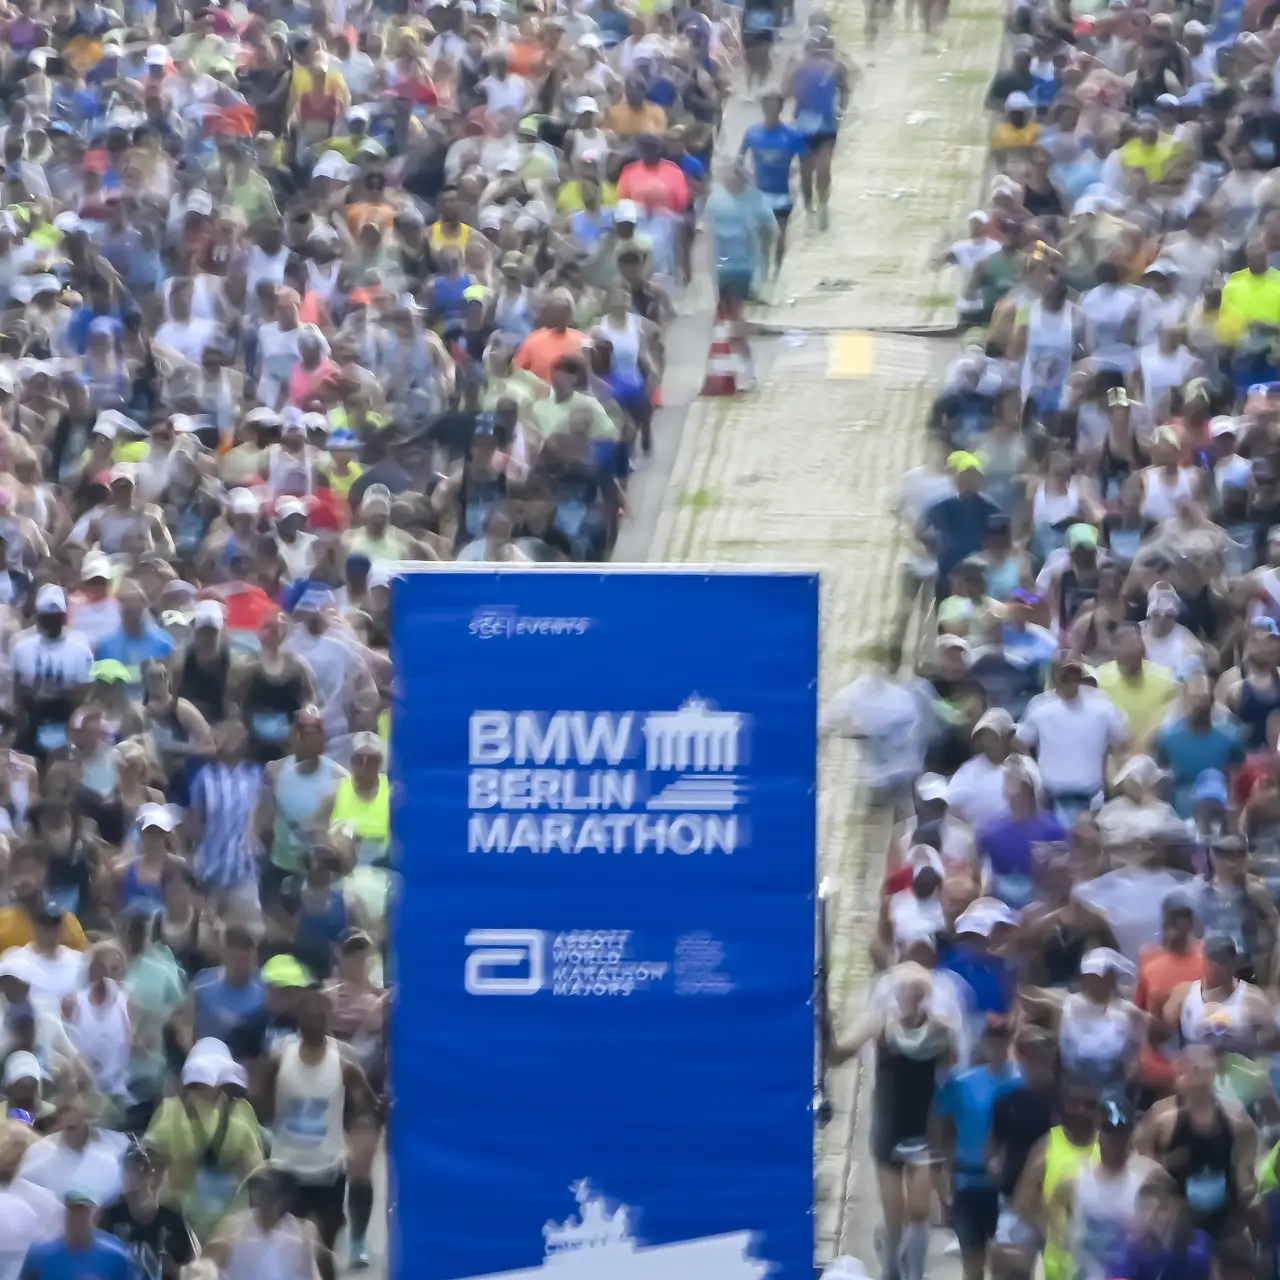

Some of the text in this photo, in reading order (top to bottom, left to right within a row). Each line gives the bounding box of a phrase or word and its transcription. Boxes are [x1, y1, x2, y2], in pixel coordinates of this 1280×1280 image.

[468, 711, 634, 765] BMW
[468, 769, 636, 810] BERLIN
[468, 813, 739, 855] MARATHON
[553, 950, 622, 965] WORLD
[553, 962, 668, 981] MARATHON
[553, 981, 634, 996] MAJORS
